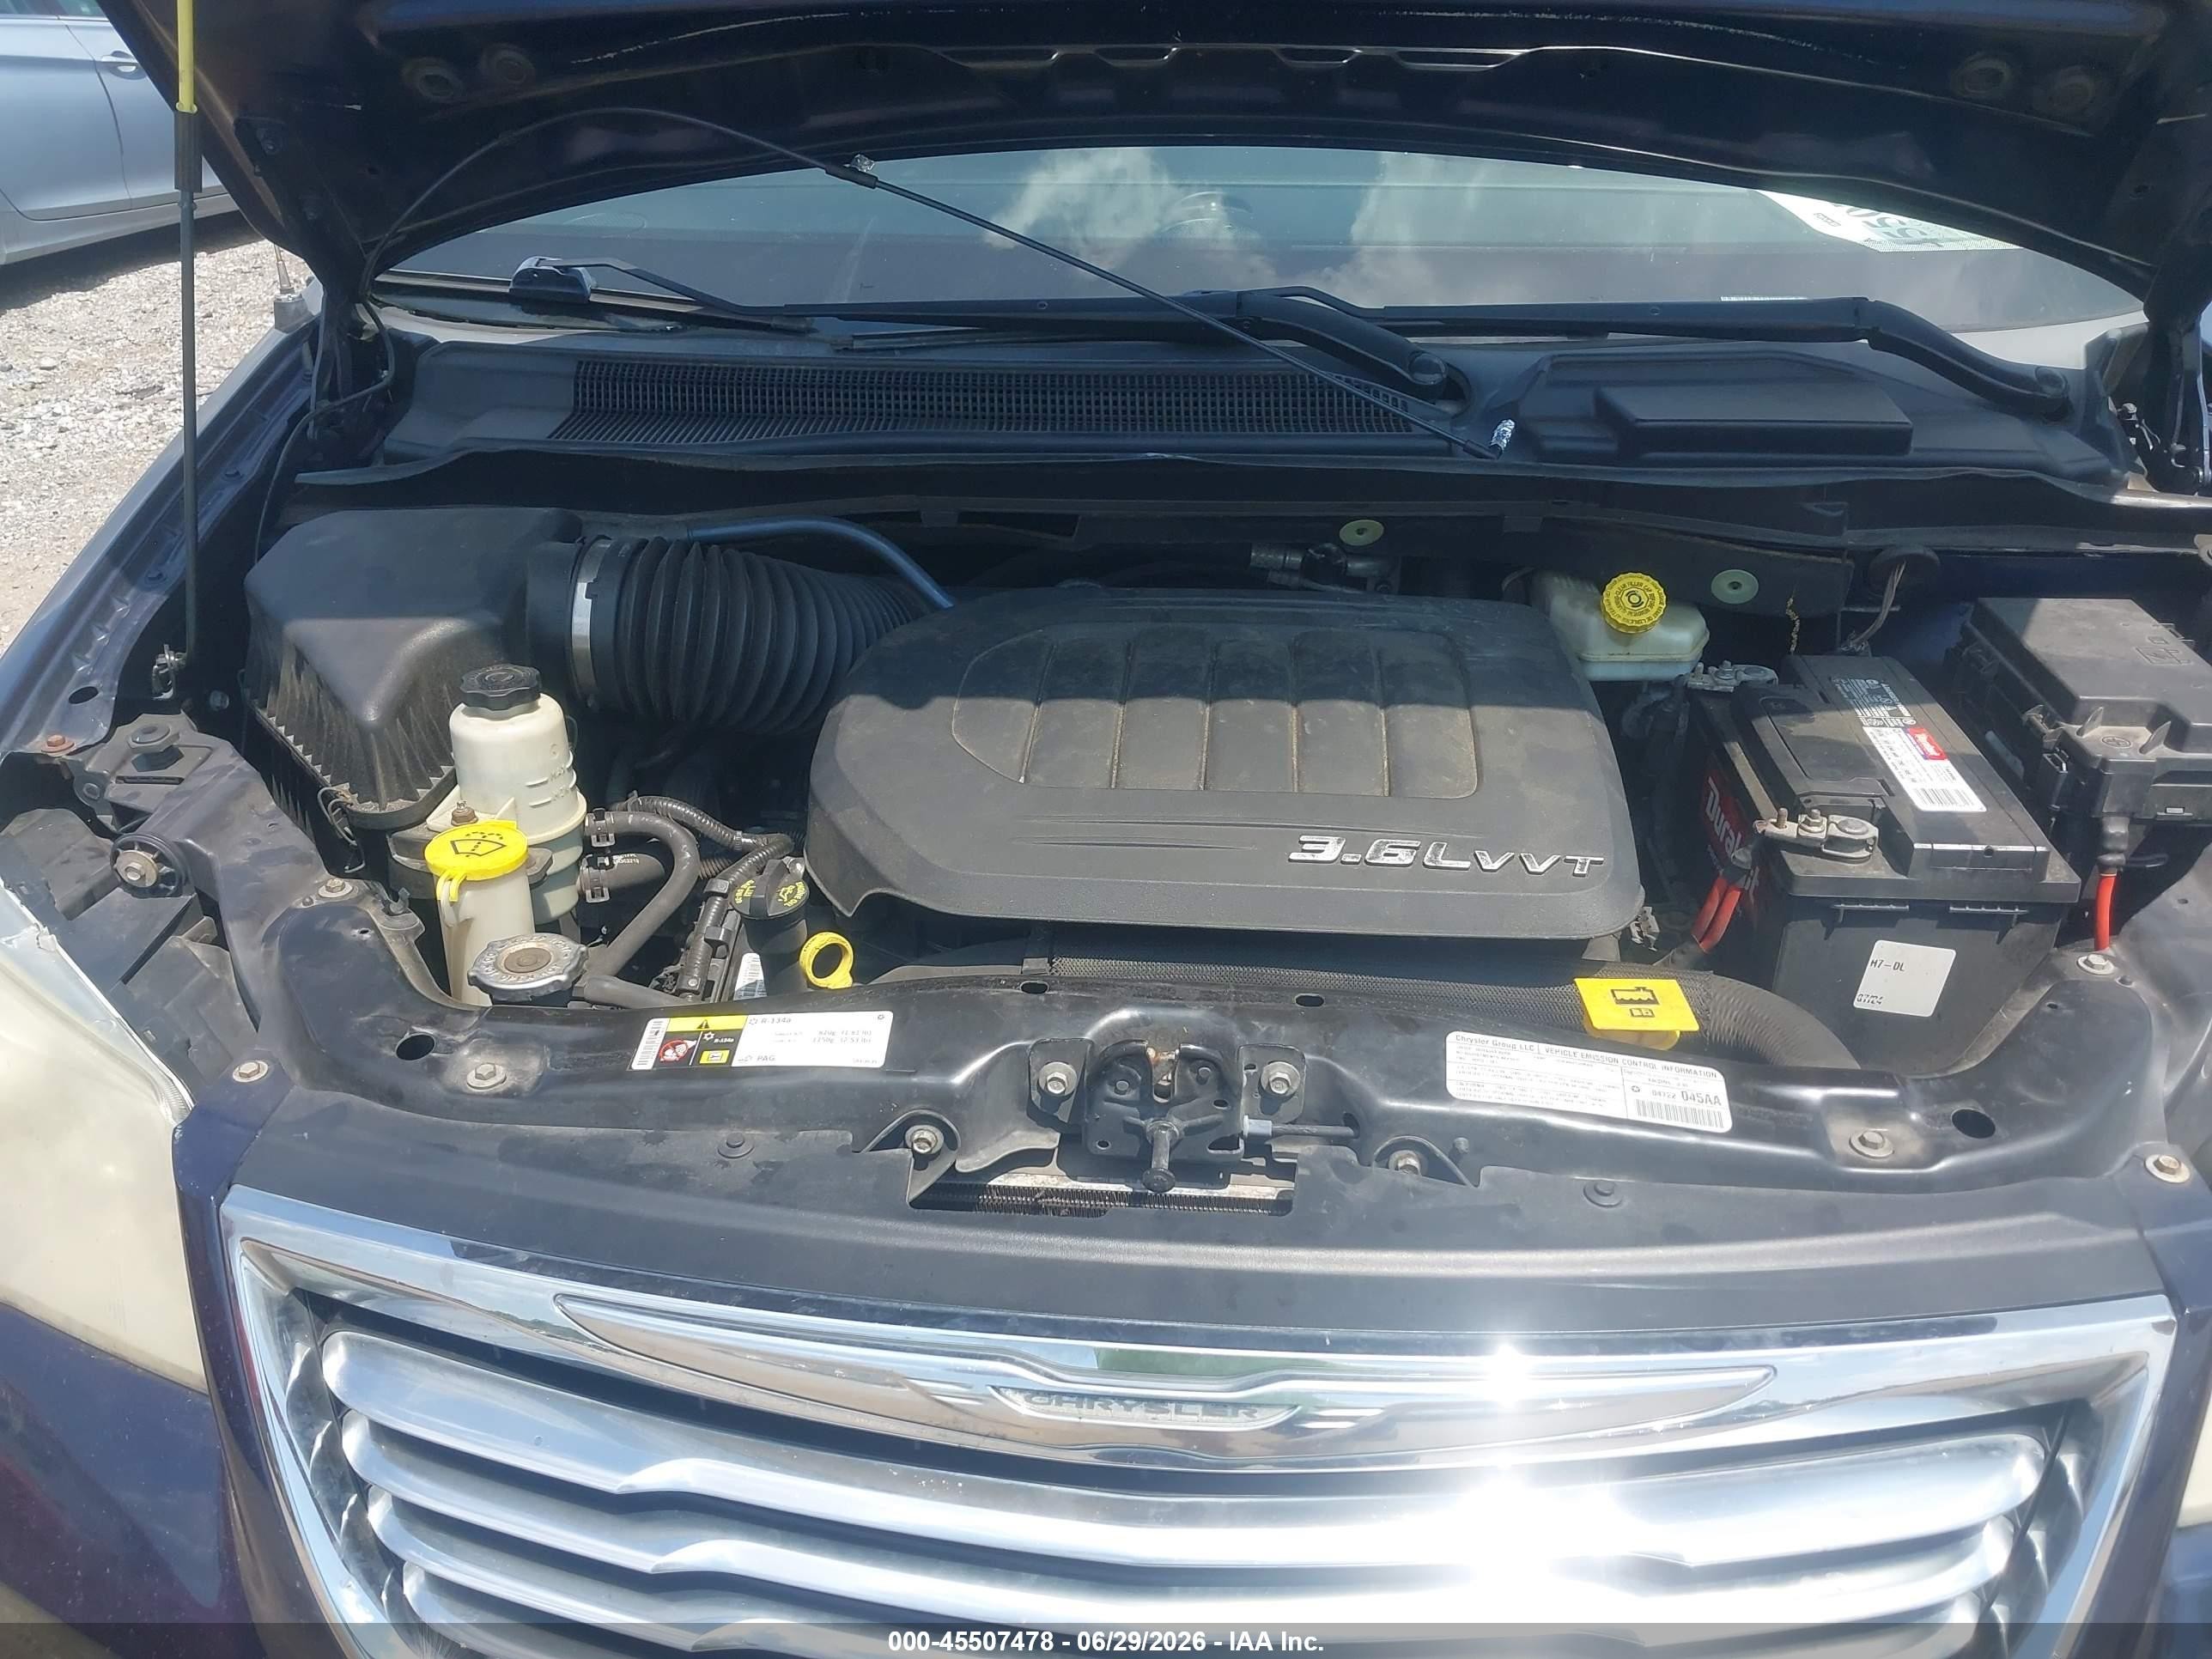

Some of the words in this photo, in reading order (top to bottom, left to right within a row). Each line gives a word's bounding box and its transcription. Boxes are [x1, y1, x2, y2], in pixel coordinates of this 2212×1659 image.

[1455, 1034, 1489, 1047] Chrysler
[1492, 1040, 1516, 1051] Group
[1520, 1042, 1535, 1052] LLC
[1545, 1048, 1578, 1060] VEHICLE
[1581, 1052, 1620, 1065] EMISSION
[1622, 1058, 1659, 1071] CONTROL
[1661, 1064, 1717, 1079] INFORMATION
[1023, 1394, 1259, 1419] CHRYSLER
